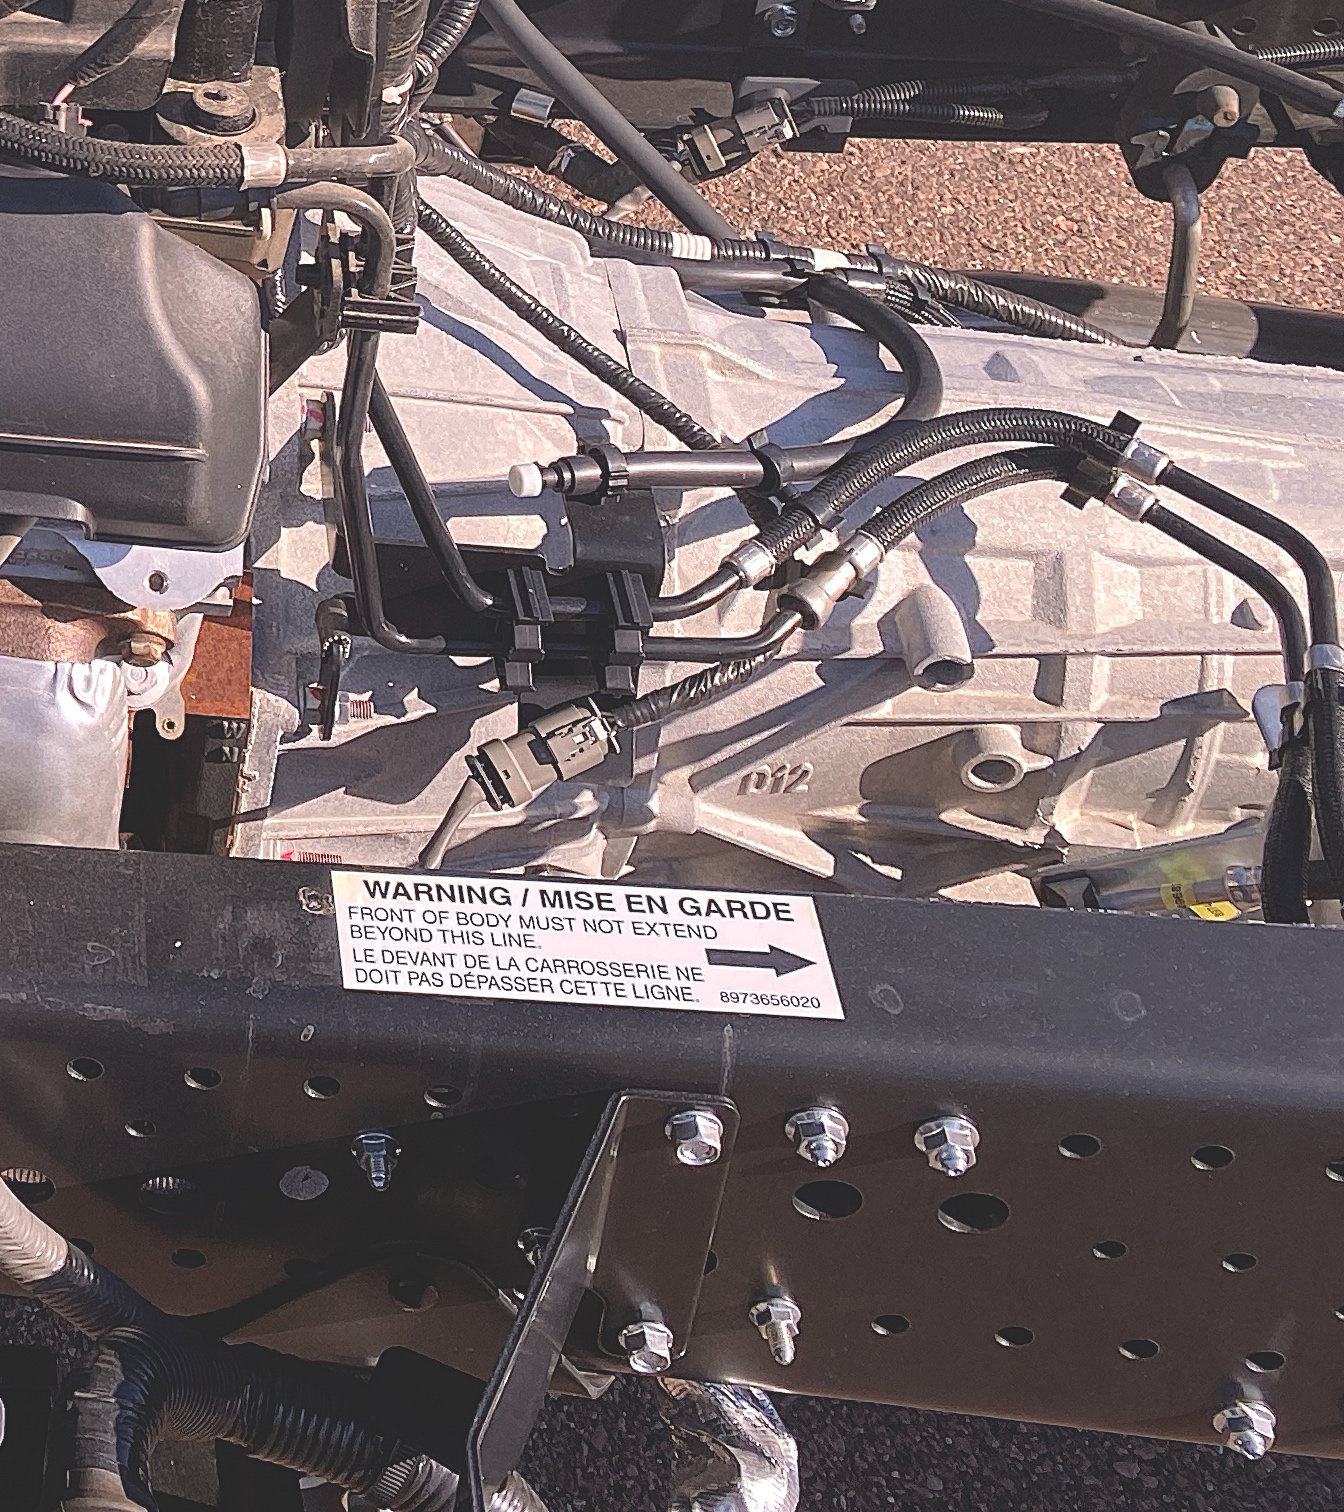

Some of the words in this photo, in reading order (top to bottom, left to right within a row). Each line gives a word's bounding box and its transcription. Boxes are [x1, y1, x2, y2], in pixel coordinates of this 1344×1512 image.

[362, 879, 512, 906] WARNING
[521, 888, 529, 907] /
[539, 889, 616, 912] MISE
[625, 893, 669, 915] EN
[678, 896, 795, 922] GARDE
[348, 906, 415, 923] FRONT
[422, 909, 449, 925] OF
[456, 912, 511, 928] BODY
[519, 915, 576, 931] MUST
[583, 918, 624, 935] NOT
[632, 921, 718, 939] EXTEND
[350, 924, 433, 943] BEYOND
[437, 929, 484, 945] THIS
[490, 932, 542, 949] LINE.
[352, 948, 377, 964] LE
[381, 950, 457, 968] DEVANT
[464, 954, 489, 970] DE
[496, 956, 521, 972] LA
[525, 957, 669, 981] CARROSSERIE
[676, 966, 705, 982] NE
[355, 968, 402, 985] DOIT
[408, 971, 444, 988] PAS
[449, 972, 555, 994] DÉPASSER
[559, 979, 627, 998] CETTE
[631, 983, 700, 1002] LIGNE.
[719, 991, 821, 1009] 8973656020
